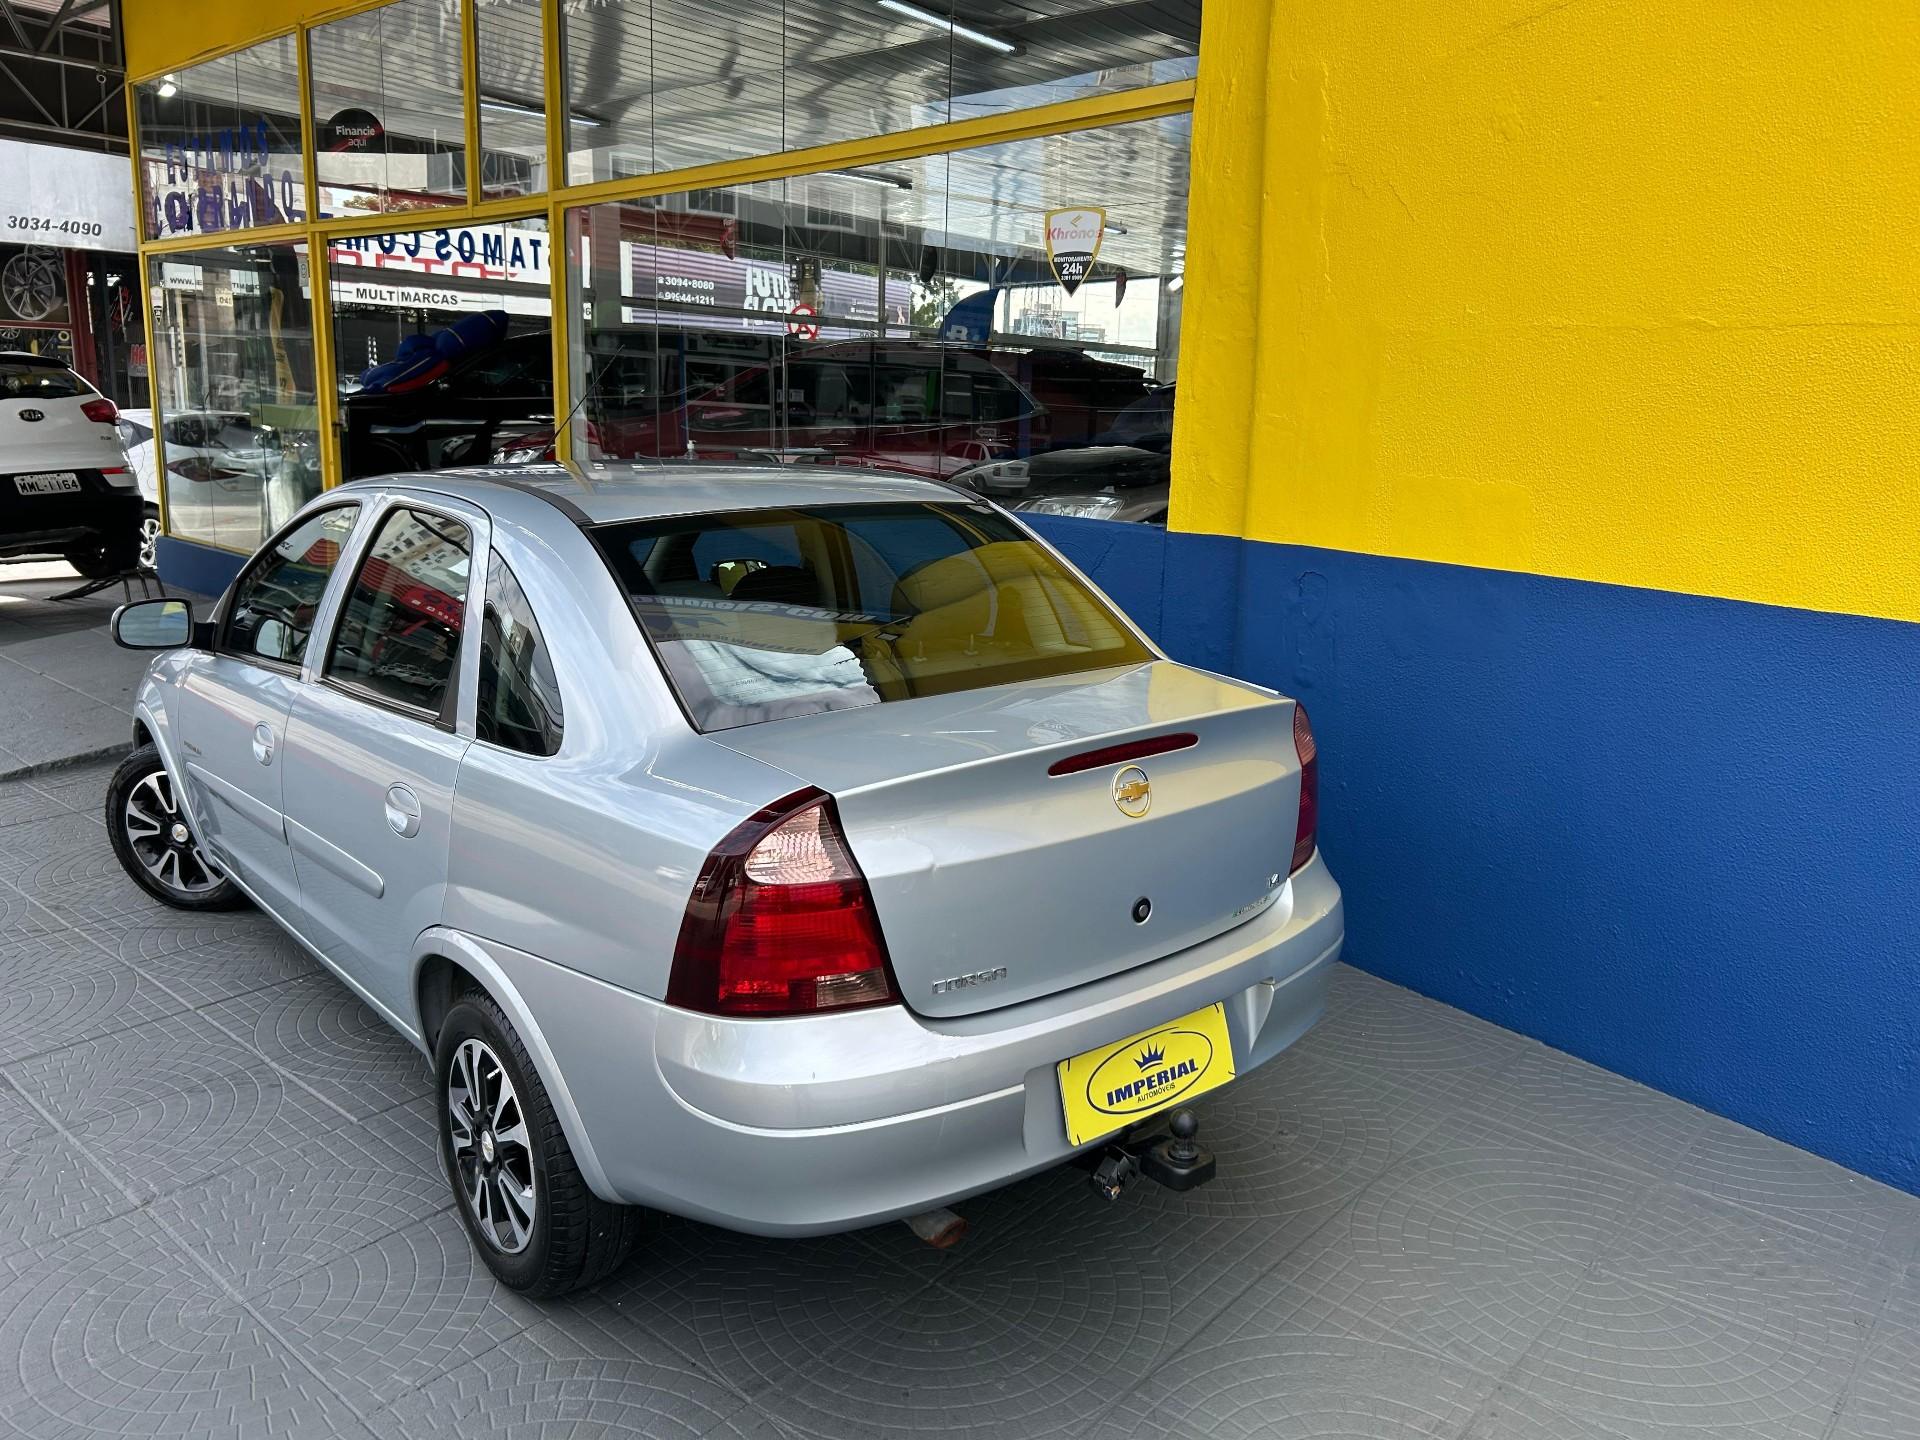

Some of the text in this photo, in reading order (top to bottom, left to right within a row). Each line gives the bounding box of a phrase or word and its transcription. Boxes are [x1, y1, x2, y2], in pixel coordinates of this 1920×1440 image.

[335, 125, 376, 136] Financie
[348, 138, 367, 149] aqui
[8, 215, 102, 237] 3034-4090
[1046, 227, 1102, 240] Khronos
[1062, 263, 1082, 275] 24h
[20, 409, 42, 421] KIA
[932, 966, 1007, 995] CORSA
[1106, 1058, 1199, 1107] IMPERIAL
[1137, 1082, 1176, 1104] AUTOMÓVEIS
